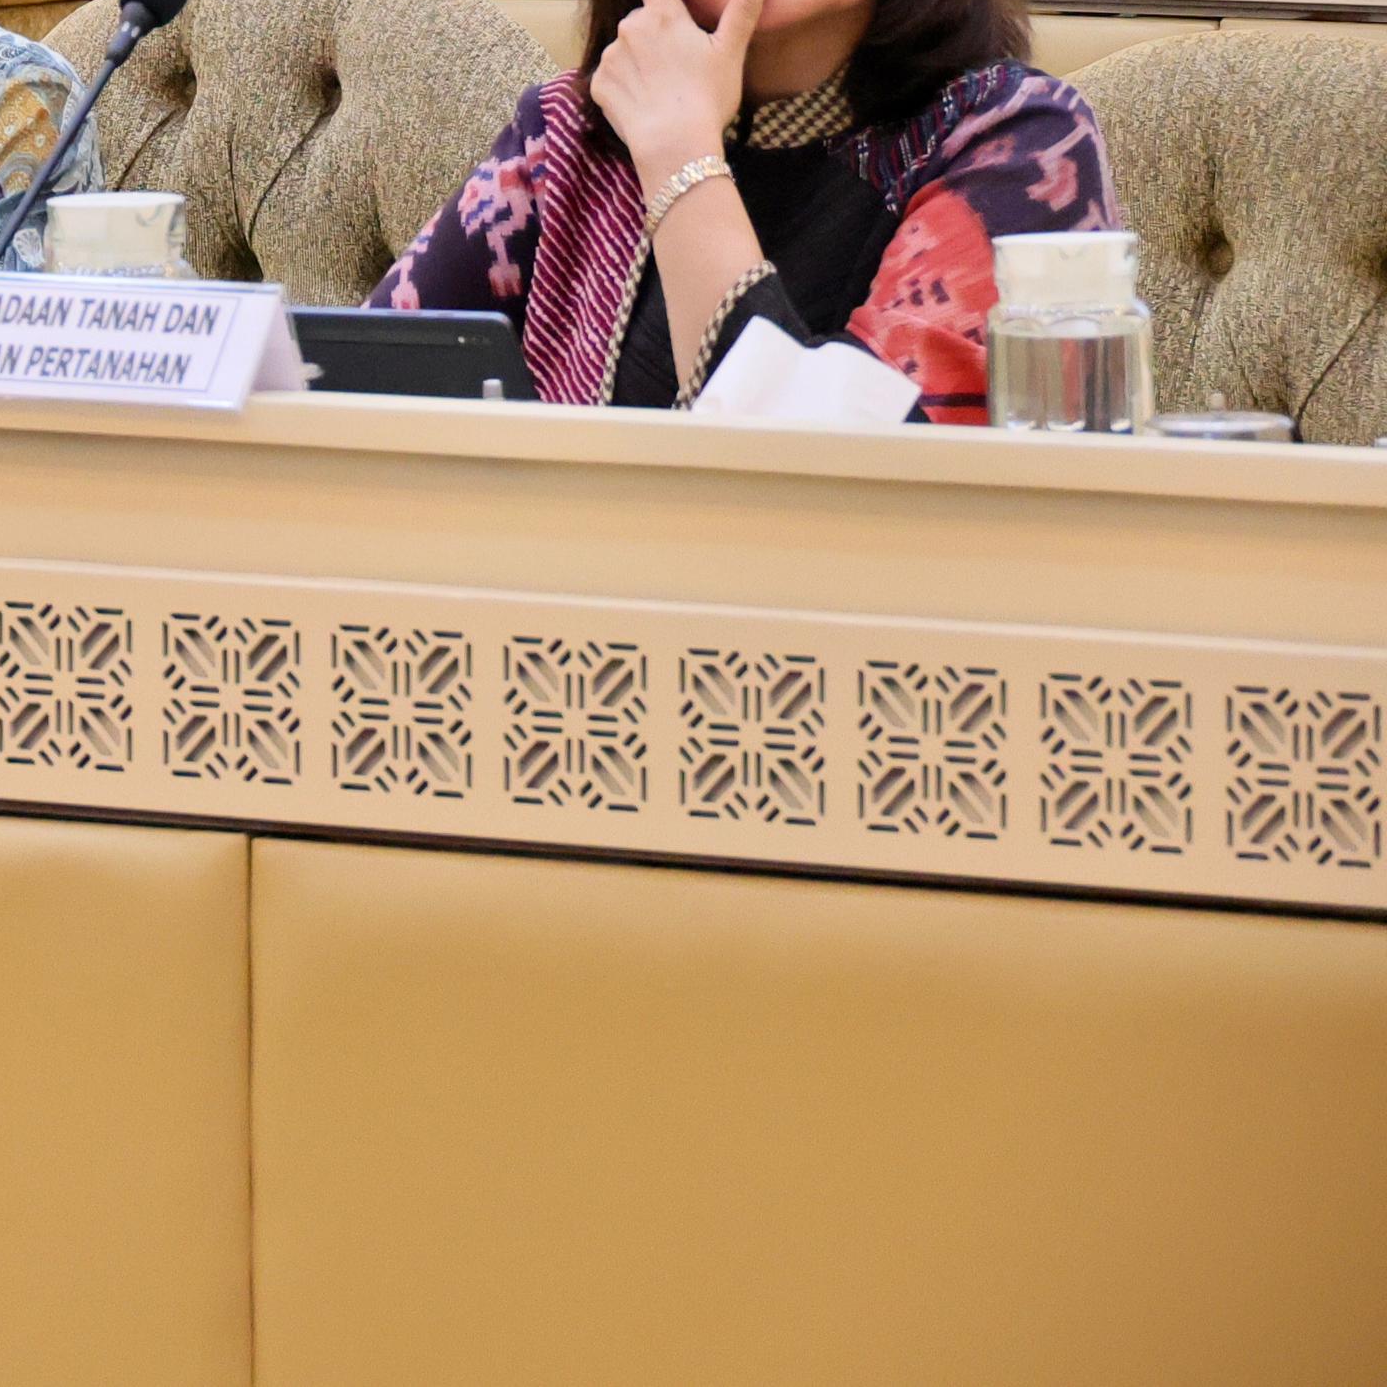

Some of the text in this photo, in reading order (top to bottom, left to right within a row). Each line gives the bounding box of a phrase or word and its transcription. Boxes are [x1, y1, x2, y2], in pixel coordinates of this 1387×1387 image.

[76, 298, 162, 334] TANAH
[162, 303, 220, 336] DAN
[23, 344, 192, 385] PERTANAHAN
